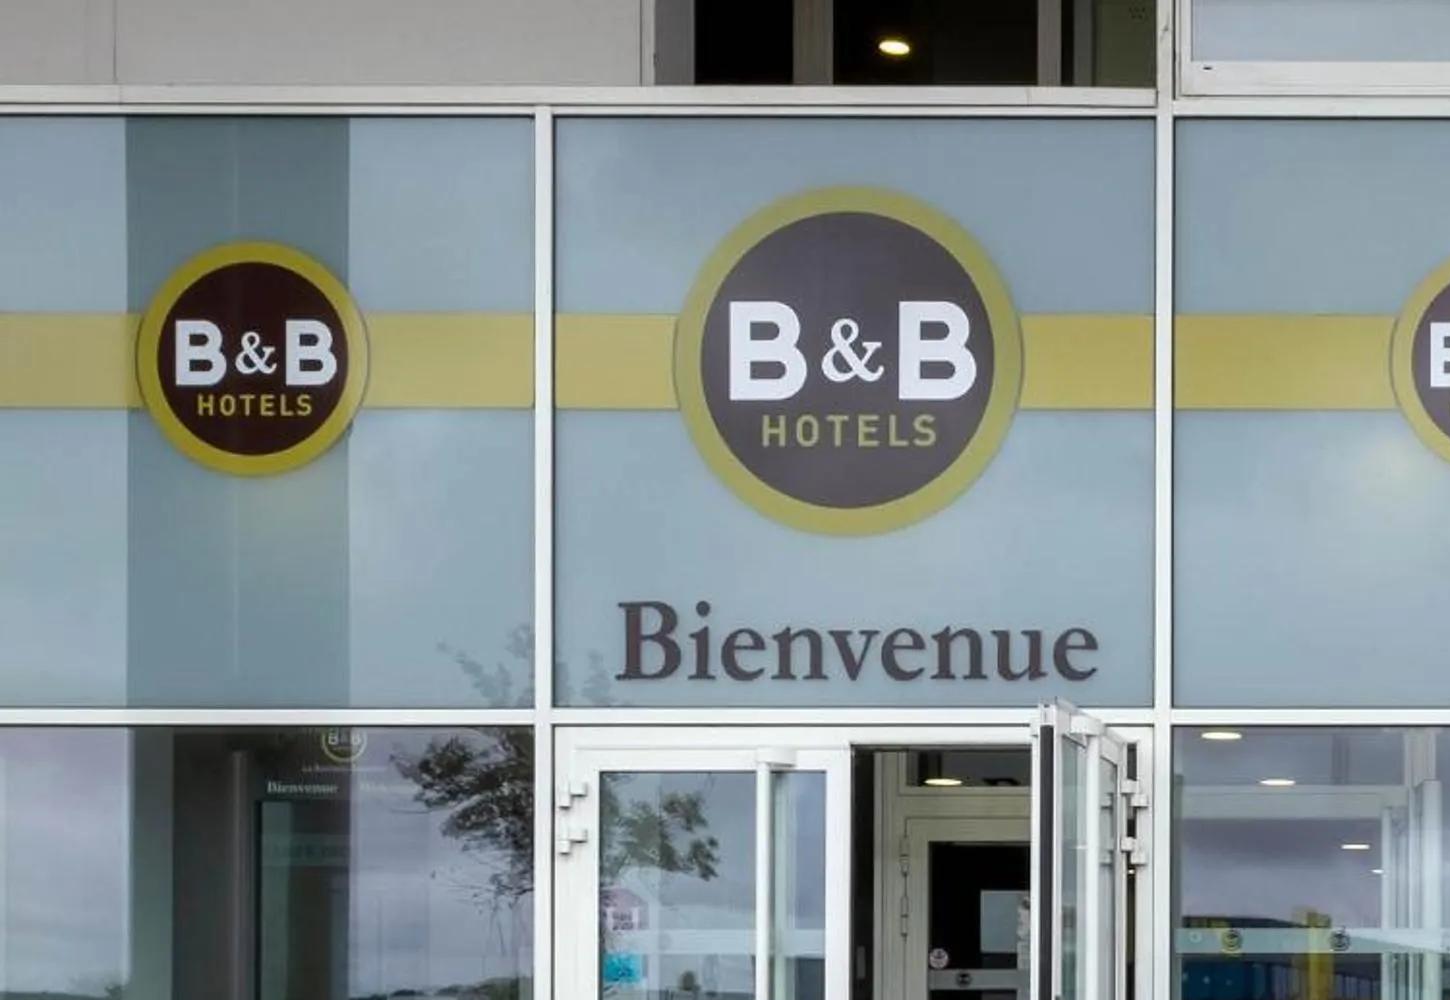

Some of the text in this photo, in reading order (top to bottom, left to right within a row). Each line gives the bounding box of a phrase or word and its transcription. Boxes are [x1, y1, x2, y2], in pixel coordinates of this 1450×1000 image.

[175, 320, 338, 386] B&B
[729, 301, 977, 401] B&B
[196, 393, 313, 418] HOTELS
[761, 414, 938, 448] HOTELS
[615, 601, 1099, 682] Bienvenue
